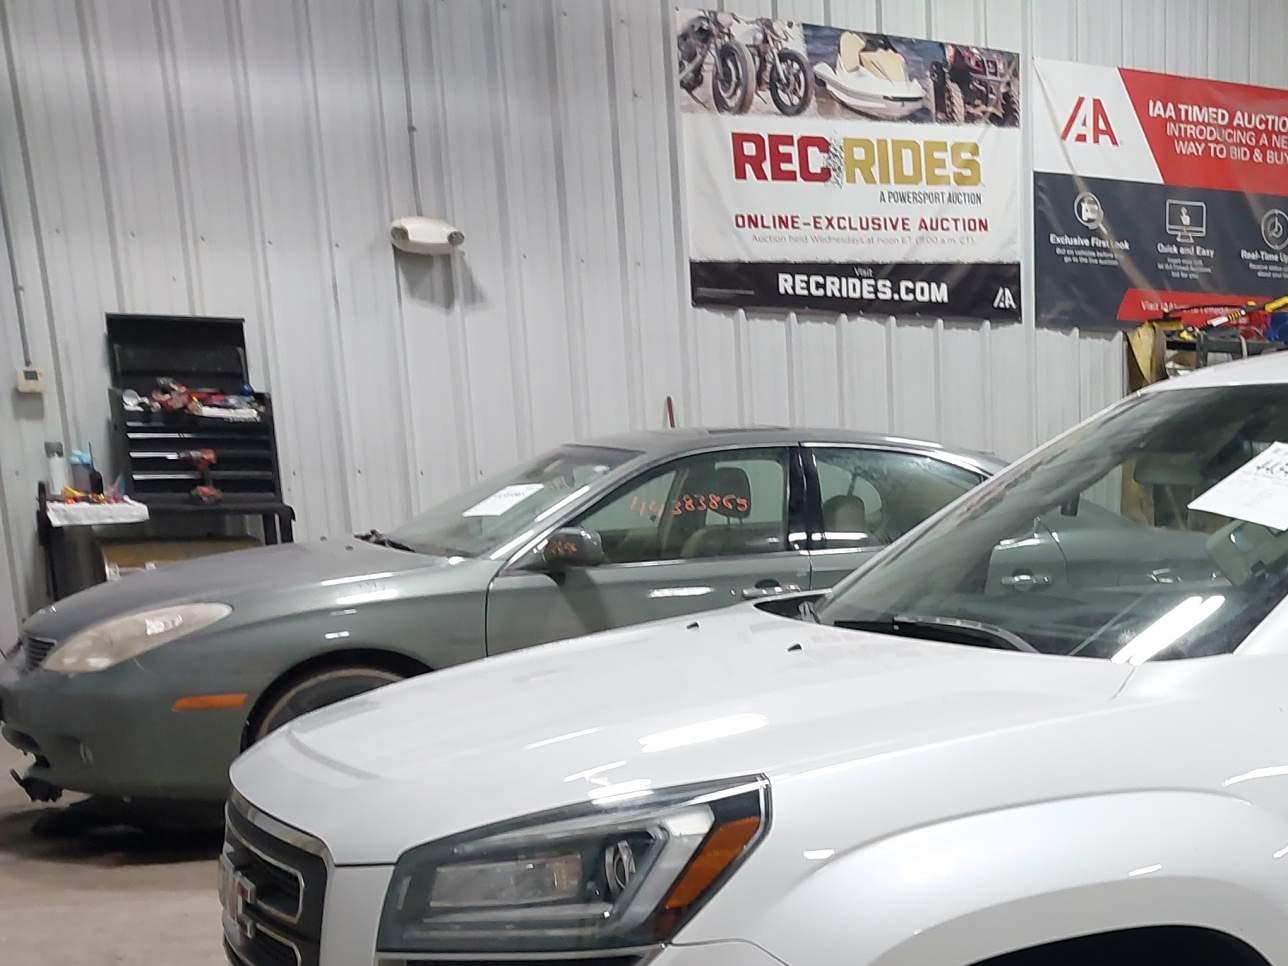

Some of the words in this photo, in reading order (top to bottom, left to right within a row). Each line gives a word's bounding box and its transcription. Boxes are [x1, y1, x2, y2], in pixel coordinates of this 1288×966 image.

[1148, 99, 1176, 120] IAA
[1178, 104, 1229, 126] TIMED
[1166, 123, 1256, 146] INTRODUCING
[1259, 134, 1269, 146] A
[1174, 140, 1204, 156] WAY
[1208, 143, 1227, 159] TO
[1229, 146, 1250, 162] BID
[1252, 149, 1264, 163] &
[842, 137, 983, 187] RIDES
[879, 190, 886, 204] A
[887, 191, 946, 205] POWERSPORT
[947, 193, 982, 206] AUCTION
[734, 213, 911, 232] ONLINE-EXCLUSIVE
[918, 216, 989, 232] AUCTION
[752, 234, 786, 243] Auction
[1050, 234, 1089, 246] Exclusive
[1156, 243, 1178, 255] Quick
[1179, 245, 1195, 256] and
[1196, 246, 1215, 259] Easy
[1240, 249, 1279, 263] Real-Time
[853, 265, 874, 277] Visit
[778, 272, 948, 303] RECRIDES.COM
